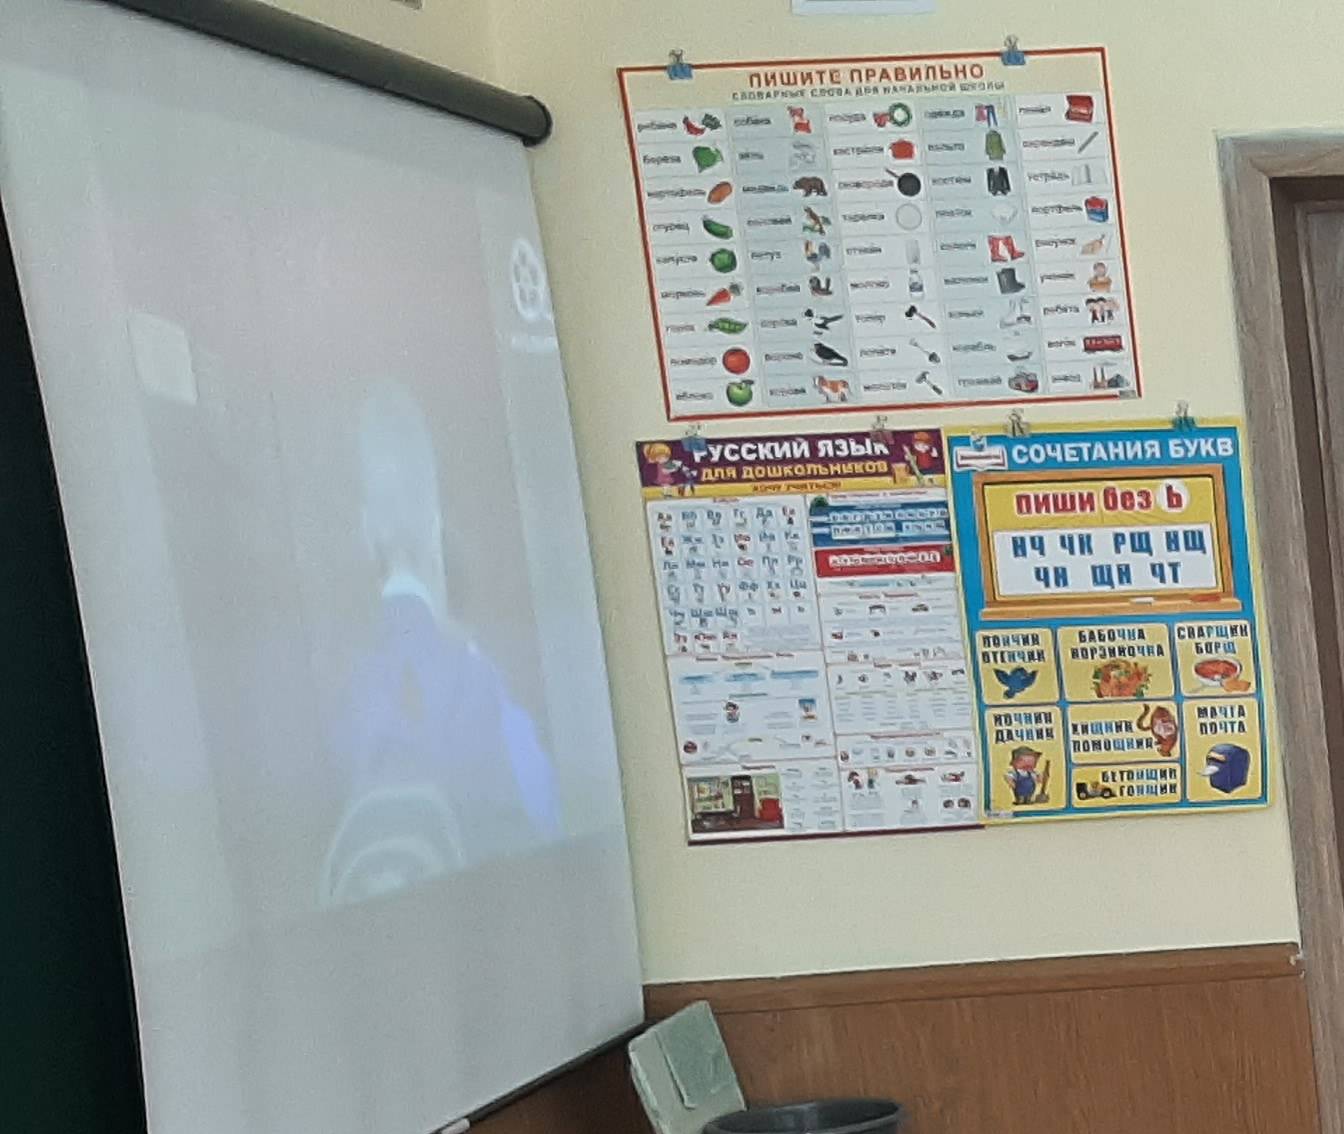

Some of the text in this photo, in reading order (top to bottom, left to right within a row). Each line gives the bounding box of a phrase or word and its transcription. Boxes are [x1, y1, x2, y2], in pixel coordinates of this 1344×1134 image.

[750, 63, 984, 89] ПИШИТЕ ПРАВИЛЬНО
[693, 437, 890, 463] РУССКИЙ ЯЗЫК
[1012, 437, 1234, 464] СОЧЕТАНИЯ БУКВ
[701, 460, 889, 482] ДЛЯ ДОШКОЛЬНИКОВ
[1102, 486, 1153, 512] без
[1113, 531, 1154, 557] РЩ
[1150, 561, 1182, 585] ЧТ
[1197, 703, 1247, 720] МАЧТА
[1199, 720, 1247, 736] ПОЧТА
